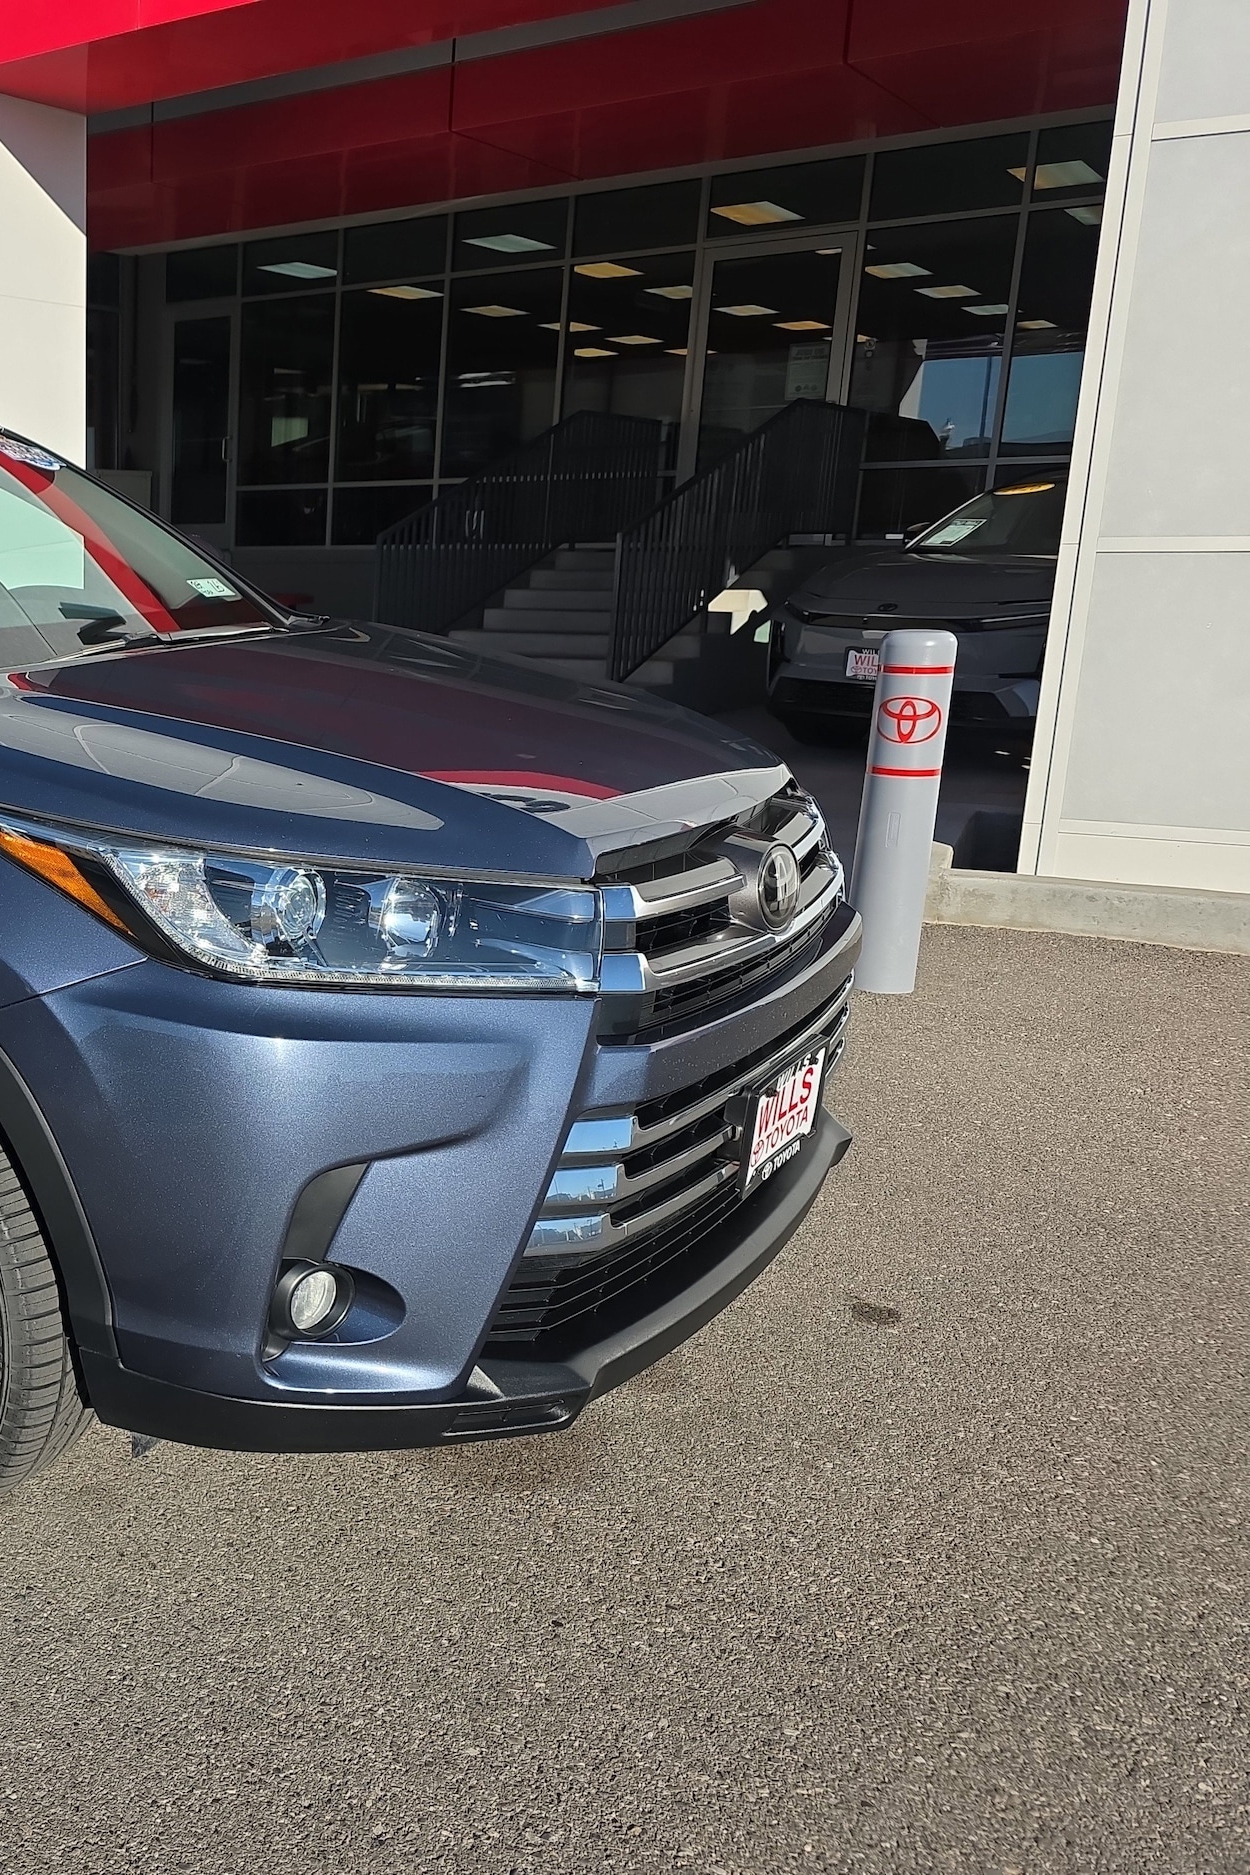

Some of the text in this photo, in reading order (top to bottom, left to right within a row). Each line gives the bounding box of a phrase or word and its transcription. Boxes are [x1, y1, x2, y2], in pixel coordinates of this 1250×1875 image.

[854, 655, 878, 667] WIL
[759, 1067, 814, 1138] WILLS
[767, 1106, 808, 1152] TOYOTA
[772, 1139, 800, 1171] TOYOTA
